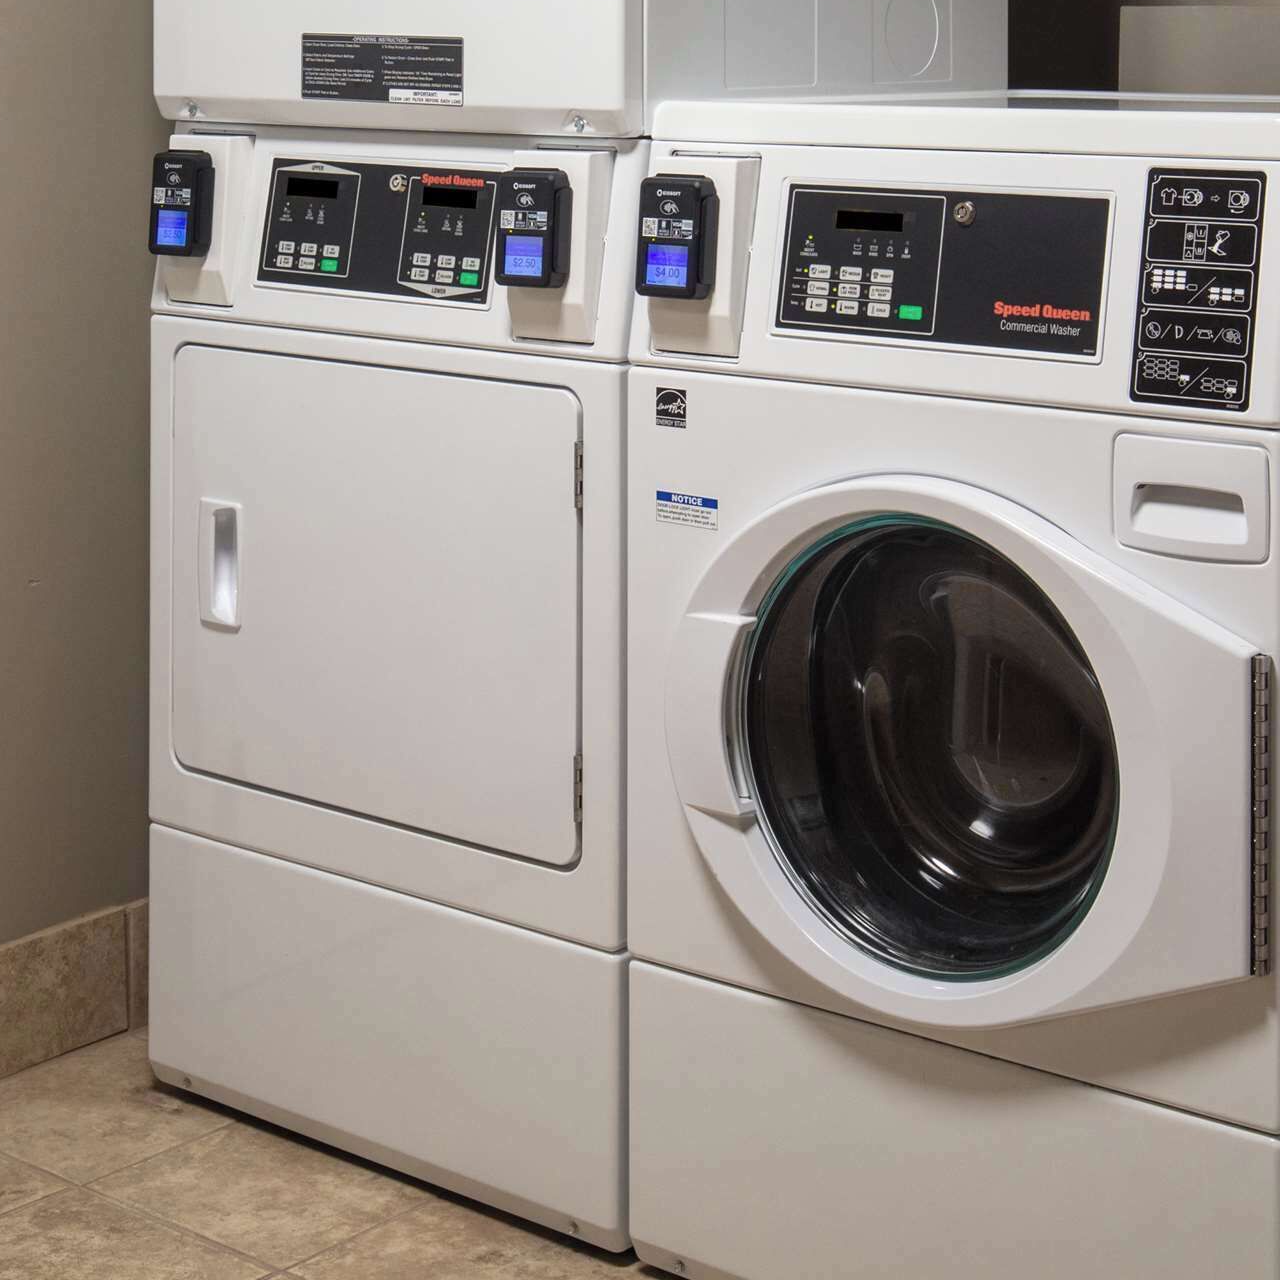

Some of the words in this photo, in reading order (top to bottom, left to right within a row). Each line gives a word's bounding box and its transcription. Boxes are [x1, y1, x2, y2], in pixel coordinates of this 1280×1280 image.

[421, 173, 452, 186] Speed
[453, 175, 484, 187] Queen
[513, 258, 536, 268] $2.50
[656, 267, 680, 278] $4.00
[994, 300, 1040, 317] Speed
[1042, 305, 1090, 320] Queen
[1000, 319, 1047, 334] Commercial
[1050, 324, 1081, 336] Washer
[672, 494, 702, 506] NOTICE
